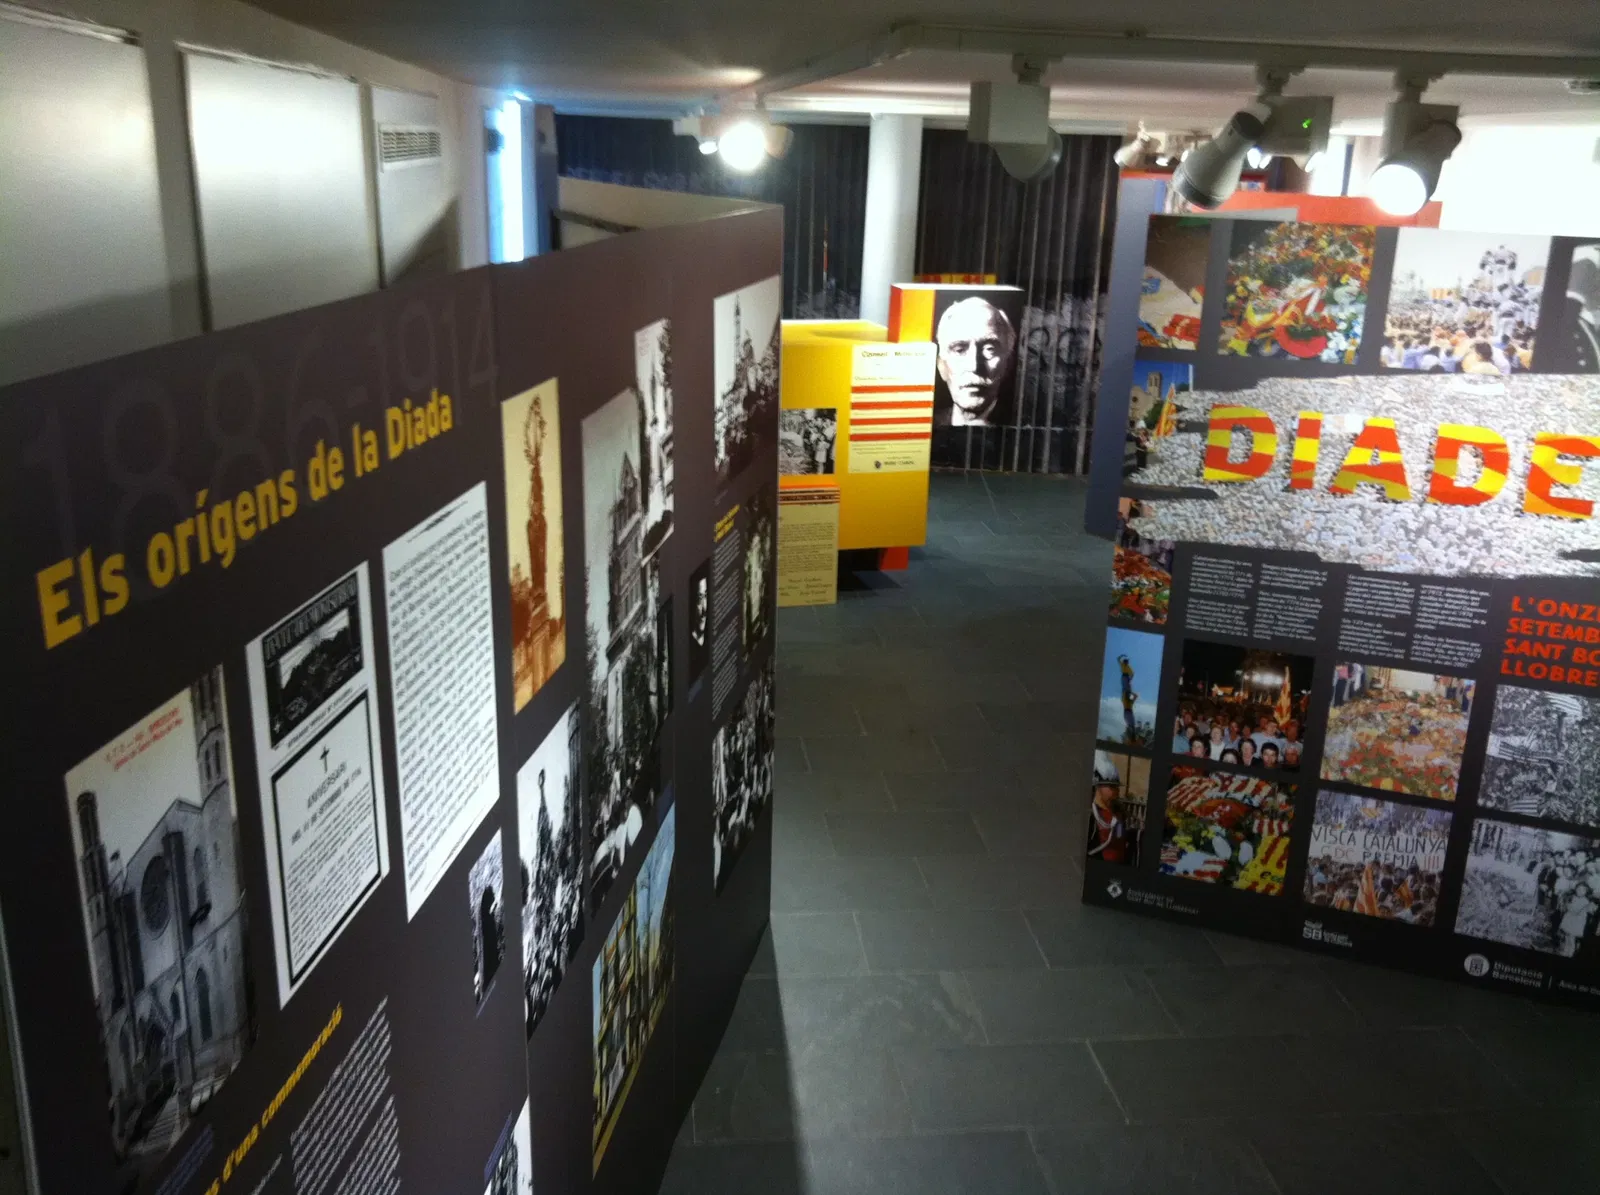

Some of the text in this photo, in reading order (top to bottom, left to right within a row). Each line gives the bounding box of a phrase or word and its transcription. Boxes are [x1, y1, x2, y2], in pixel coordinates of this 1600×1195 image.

[1203, 403, 1600, 518] DIADE
[36, 388, 453, 650] Els orígens de la Diada
[1511, 595, 1600, 623] L'ONZ
[1506, 617, 1600, 643] SETEMB
[1503, 637, 1566, 660] SANT
[1501, 658, 1600, 687] LLOBRE
[1312, 826, 1448, 854] VISCA CATALUNYA
